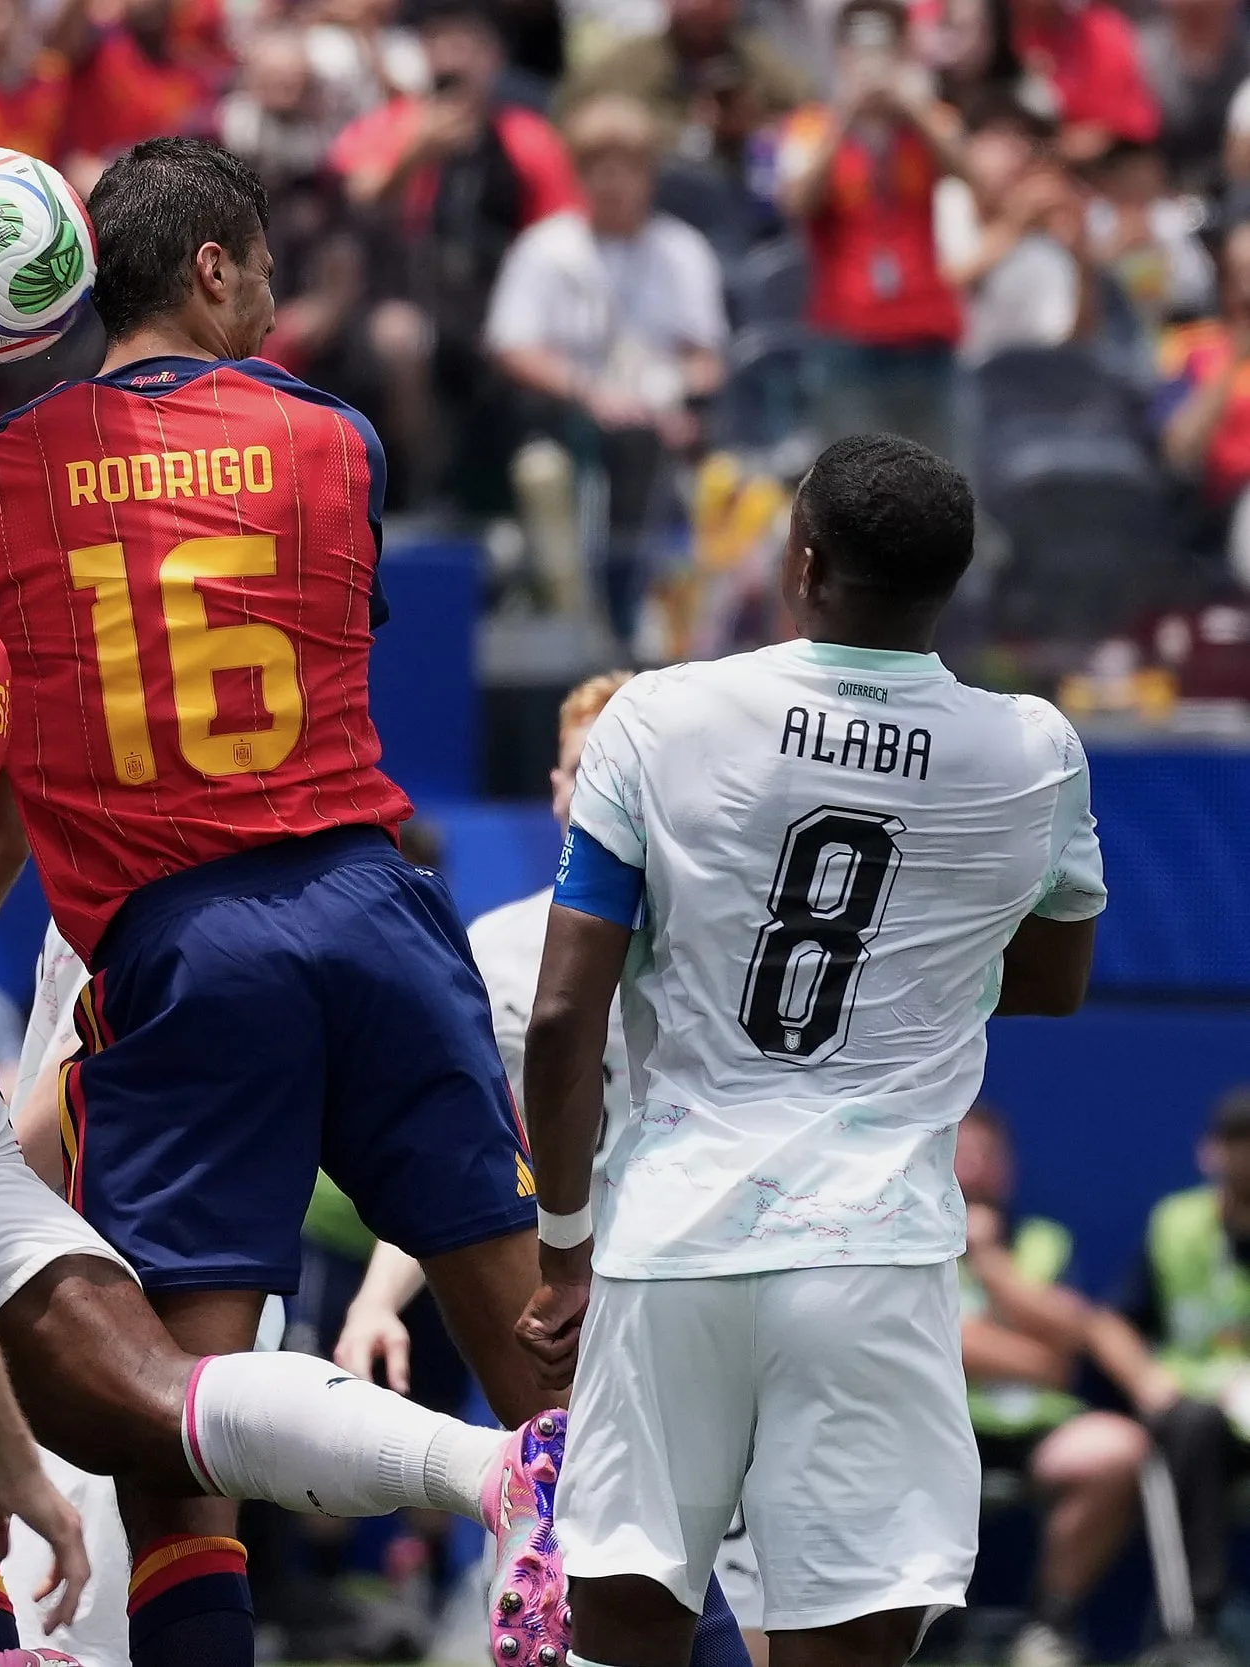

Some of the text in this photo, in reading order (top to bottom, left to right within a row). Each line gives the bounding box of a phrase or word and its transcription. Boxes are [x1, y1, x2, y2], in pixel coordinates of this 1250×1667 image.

[65, 446, 274, 507] RODRIGO
[67, 534, 305, 787] 16
[837, 679, 889, 704] ÖSTERREICH
[779, 705, 932, 781] ALABA
[737, 804, 908, 1067] 8
